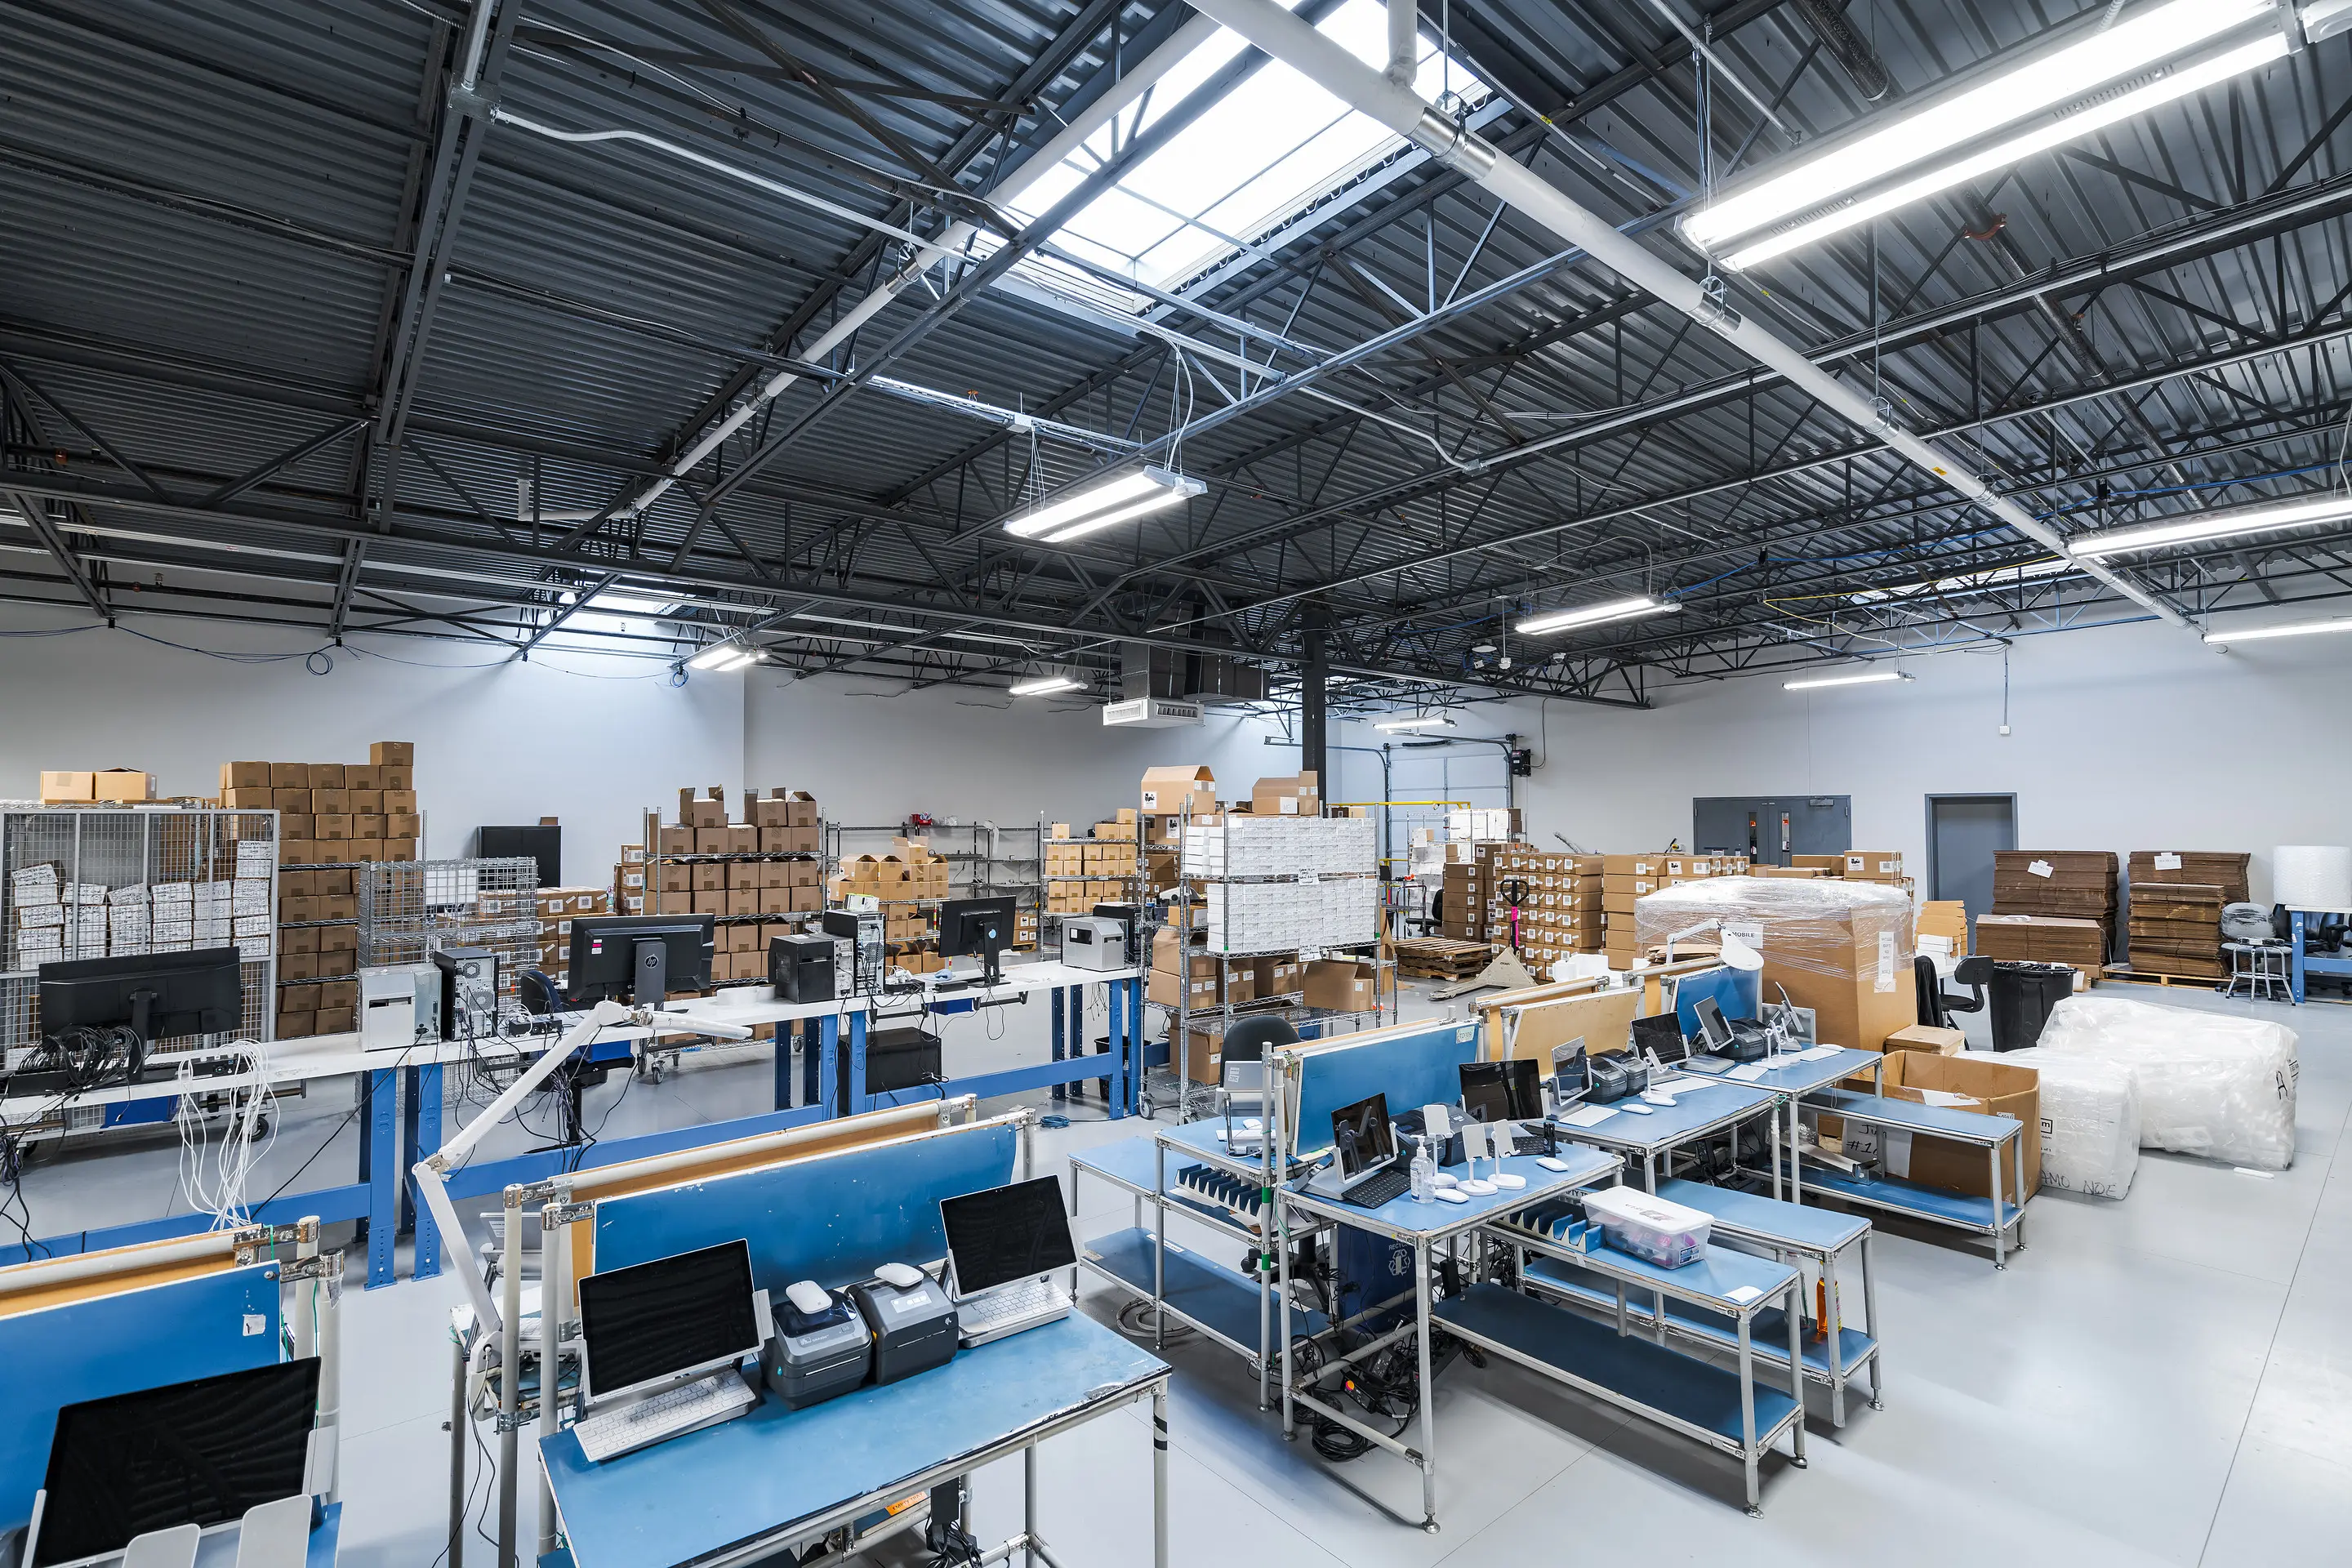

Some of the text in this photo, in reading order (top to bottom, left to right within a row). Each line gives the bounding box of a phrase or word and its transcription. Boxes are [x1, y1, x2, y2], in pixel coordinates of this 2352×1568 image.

[646, 955, 657, 969] hp
[892, 1492, 923, 1511] EMPTY TRAY
